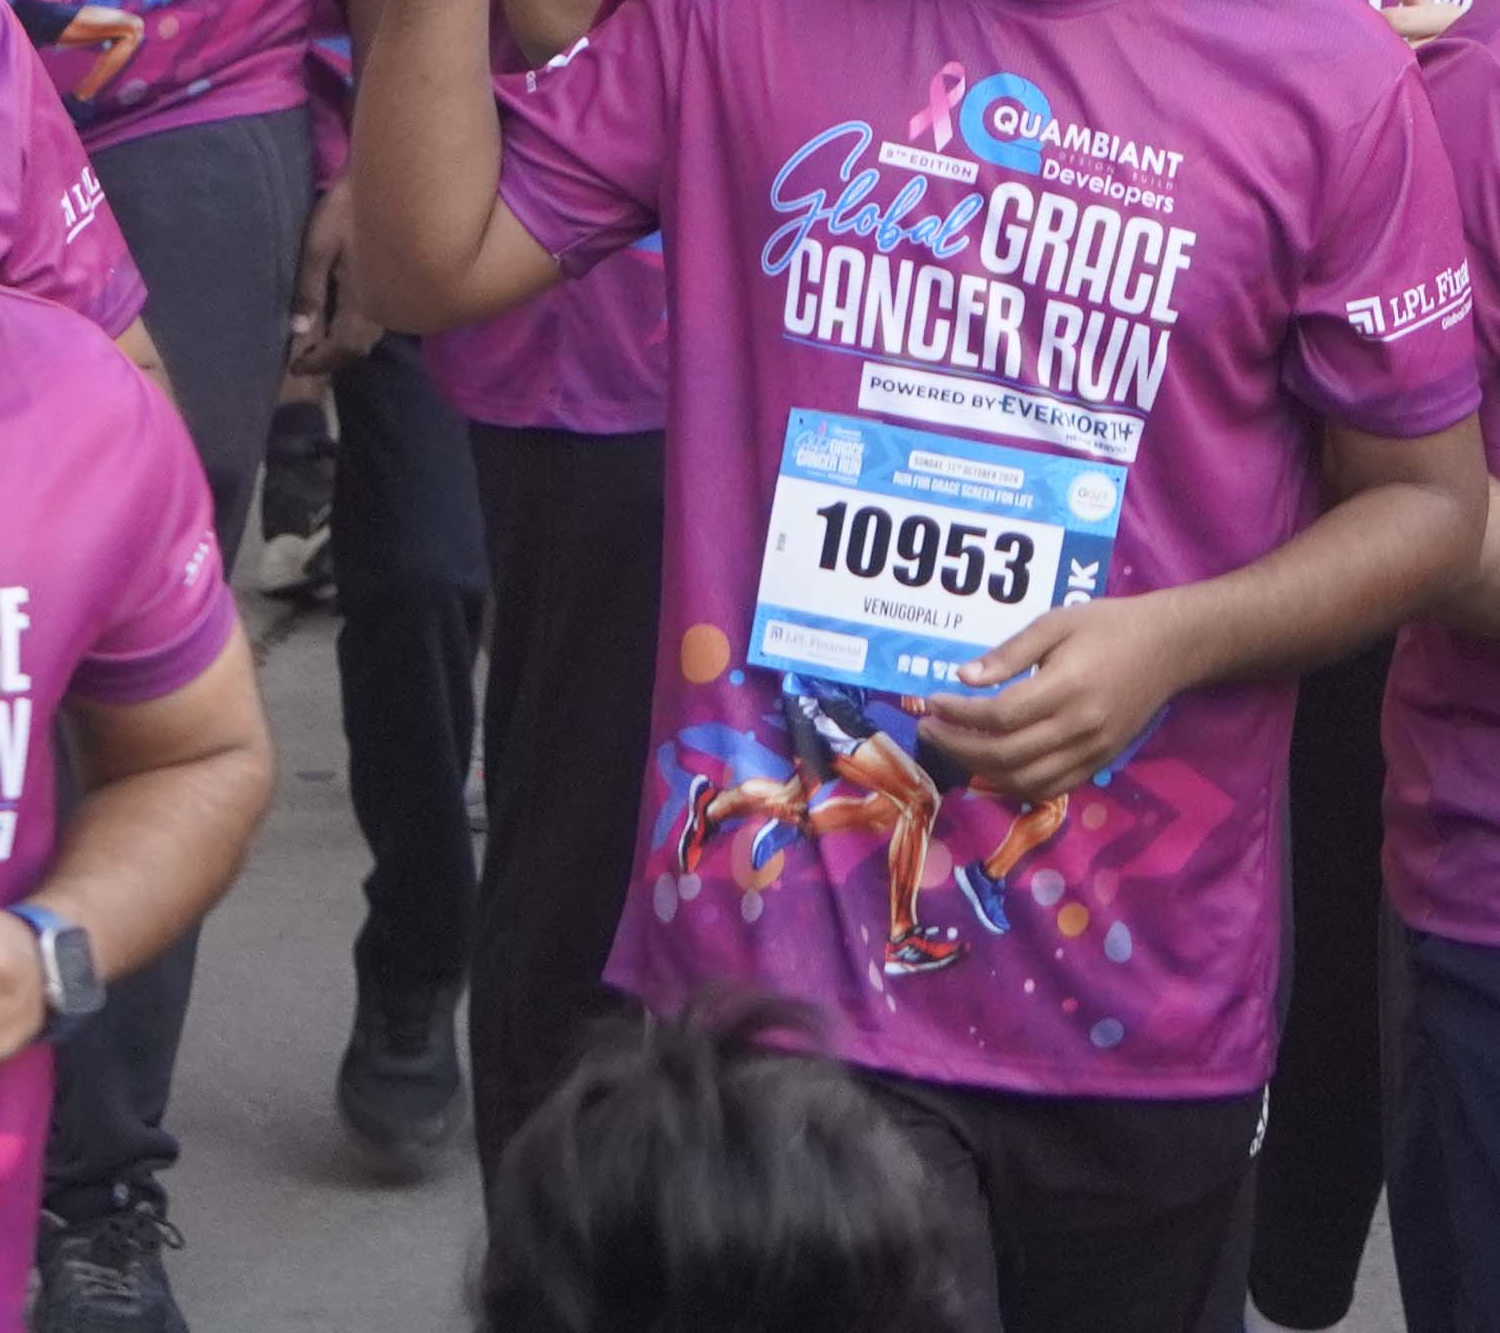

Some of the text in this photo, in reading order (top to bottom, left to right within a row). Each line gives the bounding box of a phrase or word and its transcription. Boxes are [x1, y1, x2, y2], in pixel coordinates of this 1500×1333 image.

[908, 153, 974, 179] EDITION
[992, 101, 1184, 181] QUAMBIANT
[1042, 157, 1175, 215] Developers
[761, 119, 1197, 325] Global GRACE
[782, 237, 1171, 413] CANCER RUN
[1389, 284, 1435, 327] LPL
[870, 376, 967, 409] POWERED
[971, 393, 997, 412] BY
[816, 500, 1035, 605] 10953
[863, 596, 963, 630] VENUGOPAL J P
